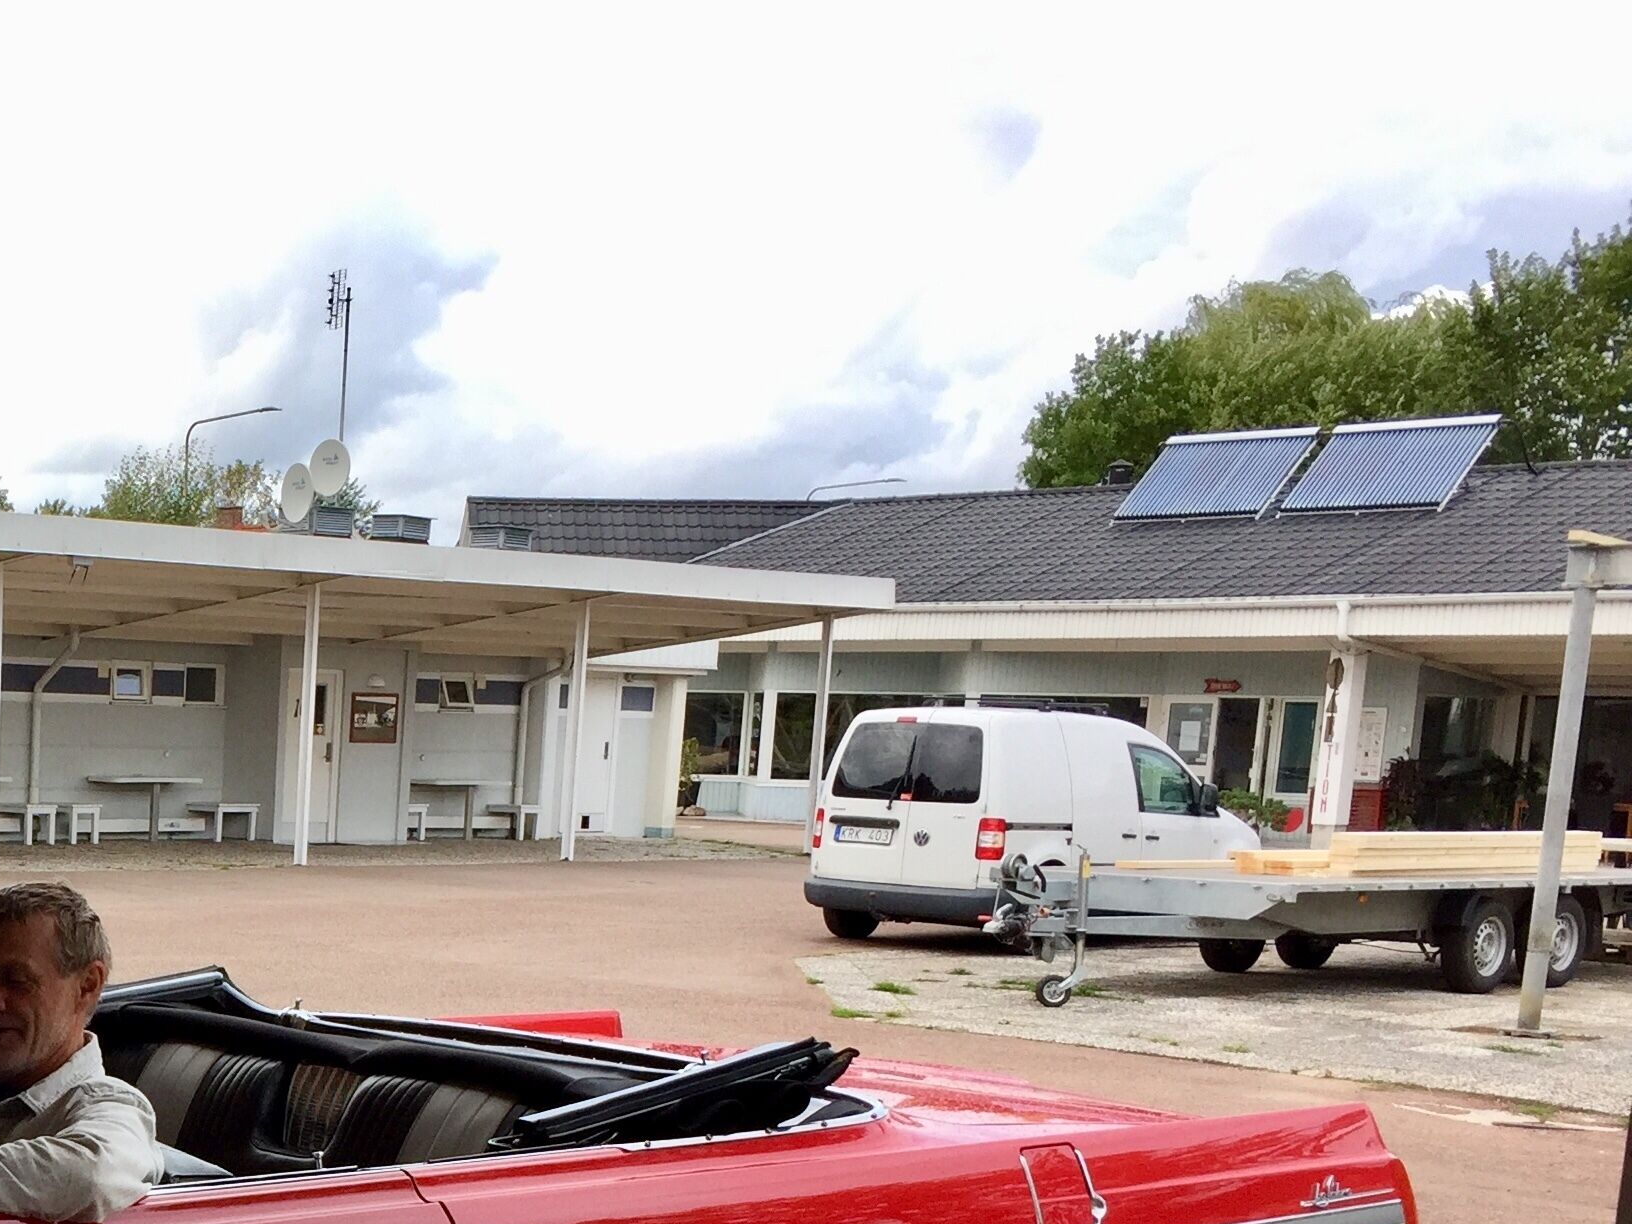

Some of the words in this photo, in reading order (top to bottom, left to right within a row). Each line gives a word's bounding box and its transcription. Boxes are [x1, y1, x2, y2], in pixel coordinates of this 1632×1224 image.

[293, 698, 302, 718] 1
[840, 828, 861, 840] KRK
[868, 829, 889, 841] 403
